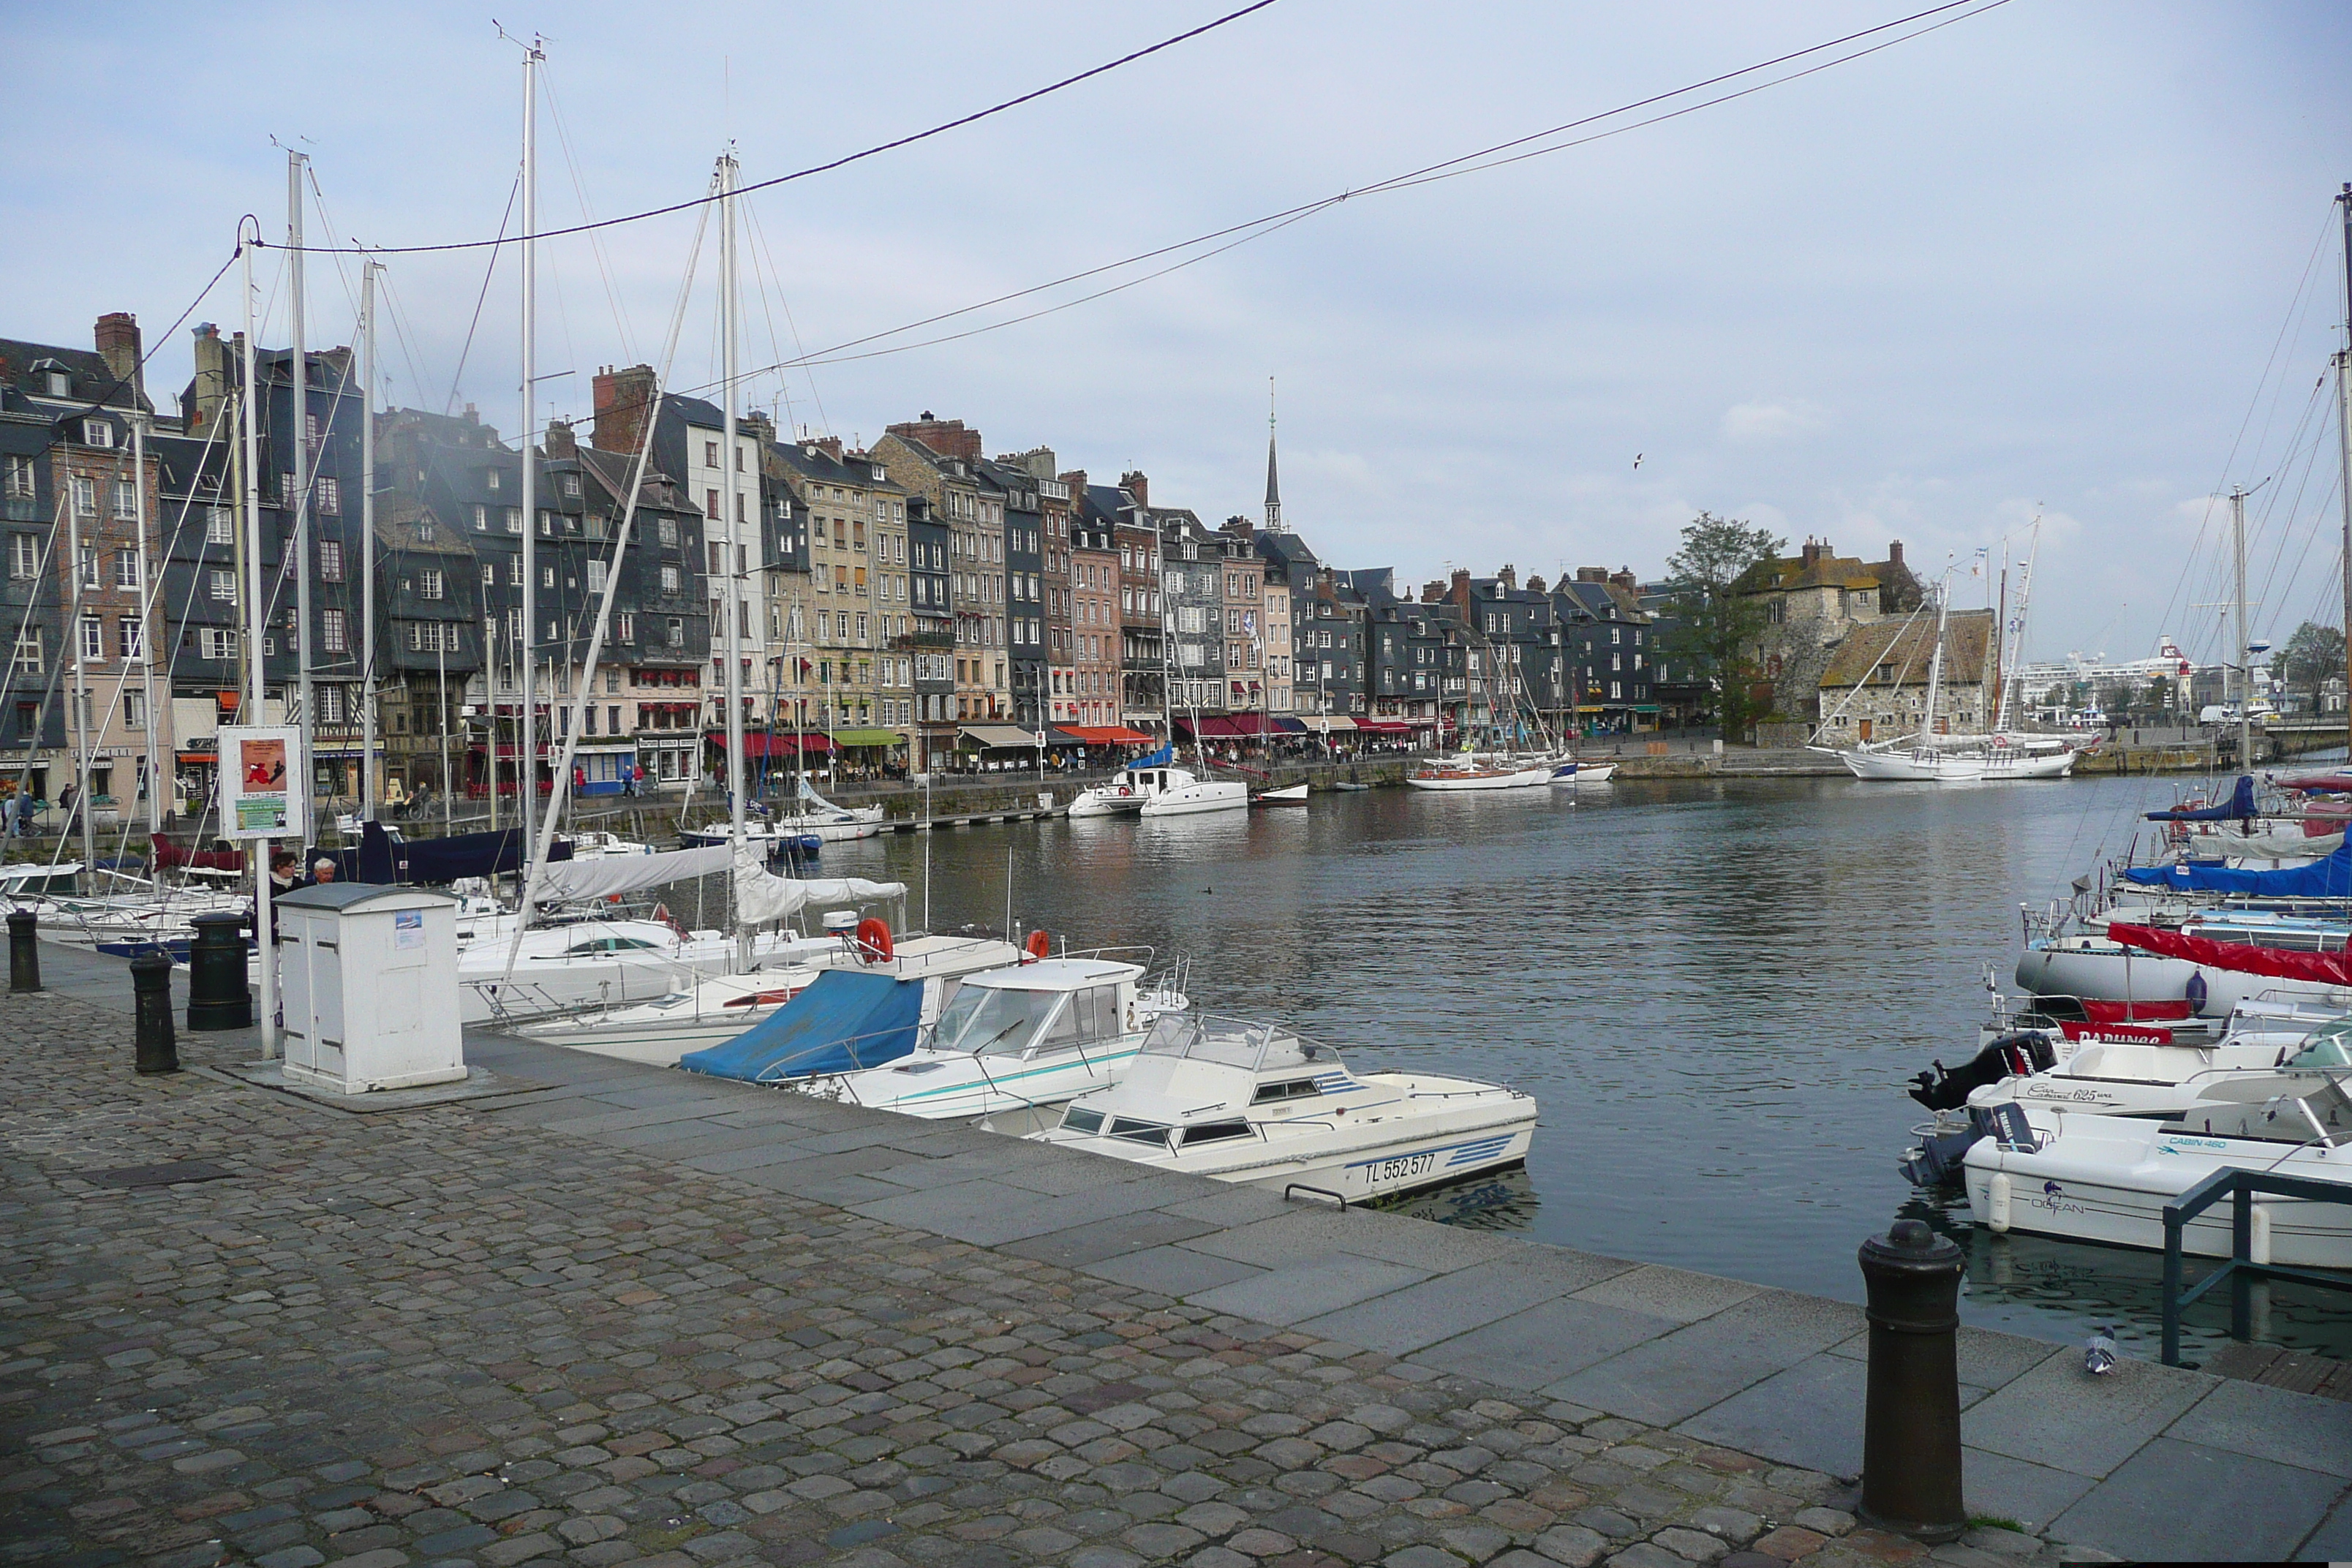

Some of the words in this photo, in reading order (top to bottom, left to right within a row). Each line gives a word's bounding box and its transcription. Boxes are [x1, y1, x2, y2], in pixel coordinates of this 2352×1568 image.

[2073, 1088, 2097, 1101] 625
[1998, 1111, 2013, 1139] YAMAHA
[2169, 1137, 2203, 1147] CABIN
[2204, 1140, 2226, 1148] 460
[1366, 1164, 1379, 1183] TL
[1384, 1158, 1409, 1180] 552
[1411, 1153, 1435, 1175] 577
[2031, 1199, 2084, 1214] OCEAN
